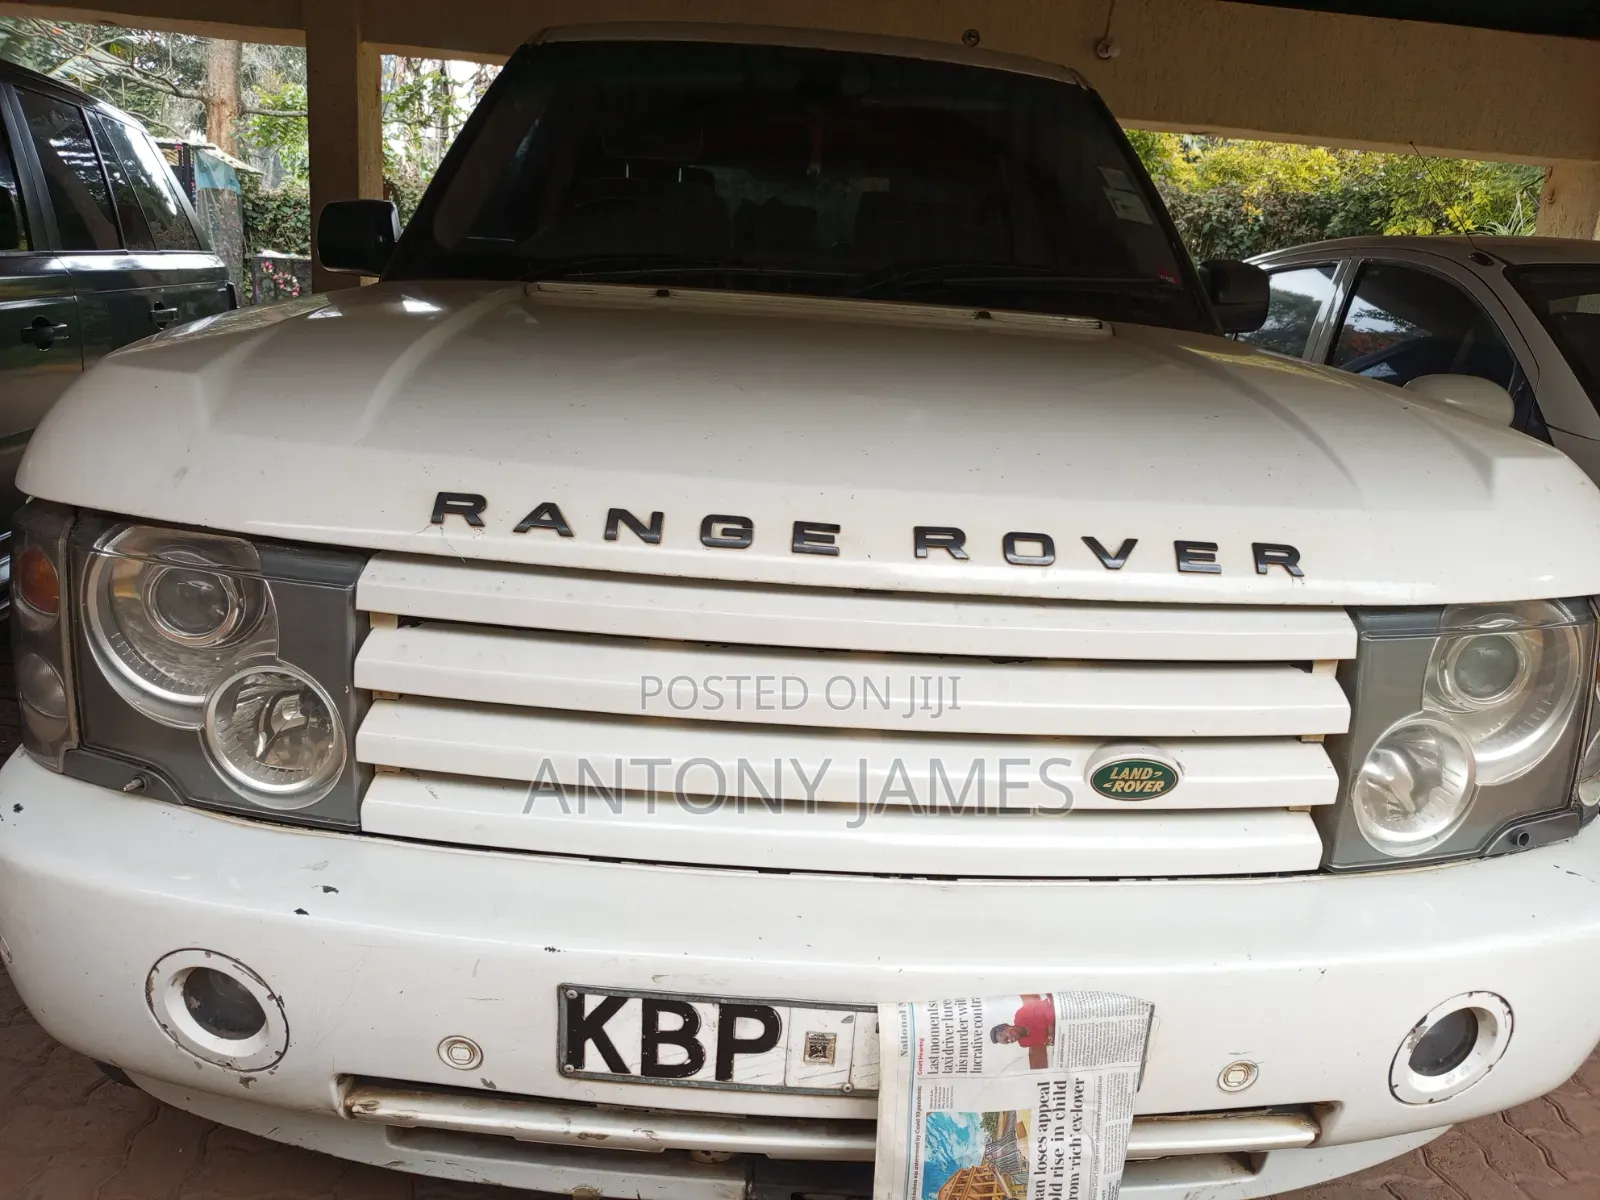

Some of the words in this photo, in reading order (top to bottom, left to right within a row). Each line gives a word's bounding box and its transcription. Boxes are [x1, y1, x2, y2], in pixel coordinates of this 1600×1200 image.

[431, 491, 841, 557] RANGE
[914, 525, 1305, 577] ROVER
[1111, 780, 1165, 792] ROVER
[567, 992, 782, 1082] KBP
[899, 1010, 908, 1057] National
[927, 1003, 940, 1054] moments
[942, 1023, 954, 1055] driver
[956, 1018, 968, 1058] murder
[927, 1056, 940, 1074] Last
[941, 1056, 953, 1074] taxi
[955, 1060, 968, 1073] his
[970, 1030, 983, 1074] lucrative
[1037, 1081, 1052, 1132] appeal
[1052, 1080, 1067, 1120] child
[1070, 1077, 1085, 1132] ex-lover
[1051, 1126, 1065, 1142] in
[1034, 1136, 1048, 1175] loses
[1050, 1148, 1064, 1178] rise
[1066, 1173, 1080, 1200] rom
